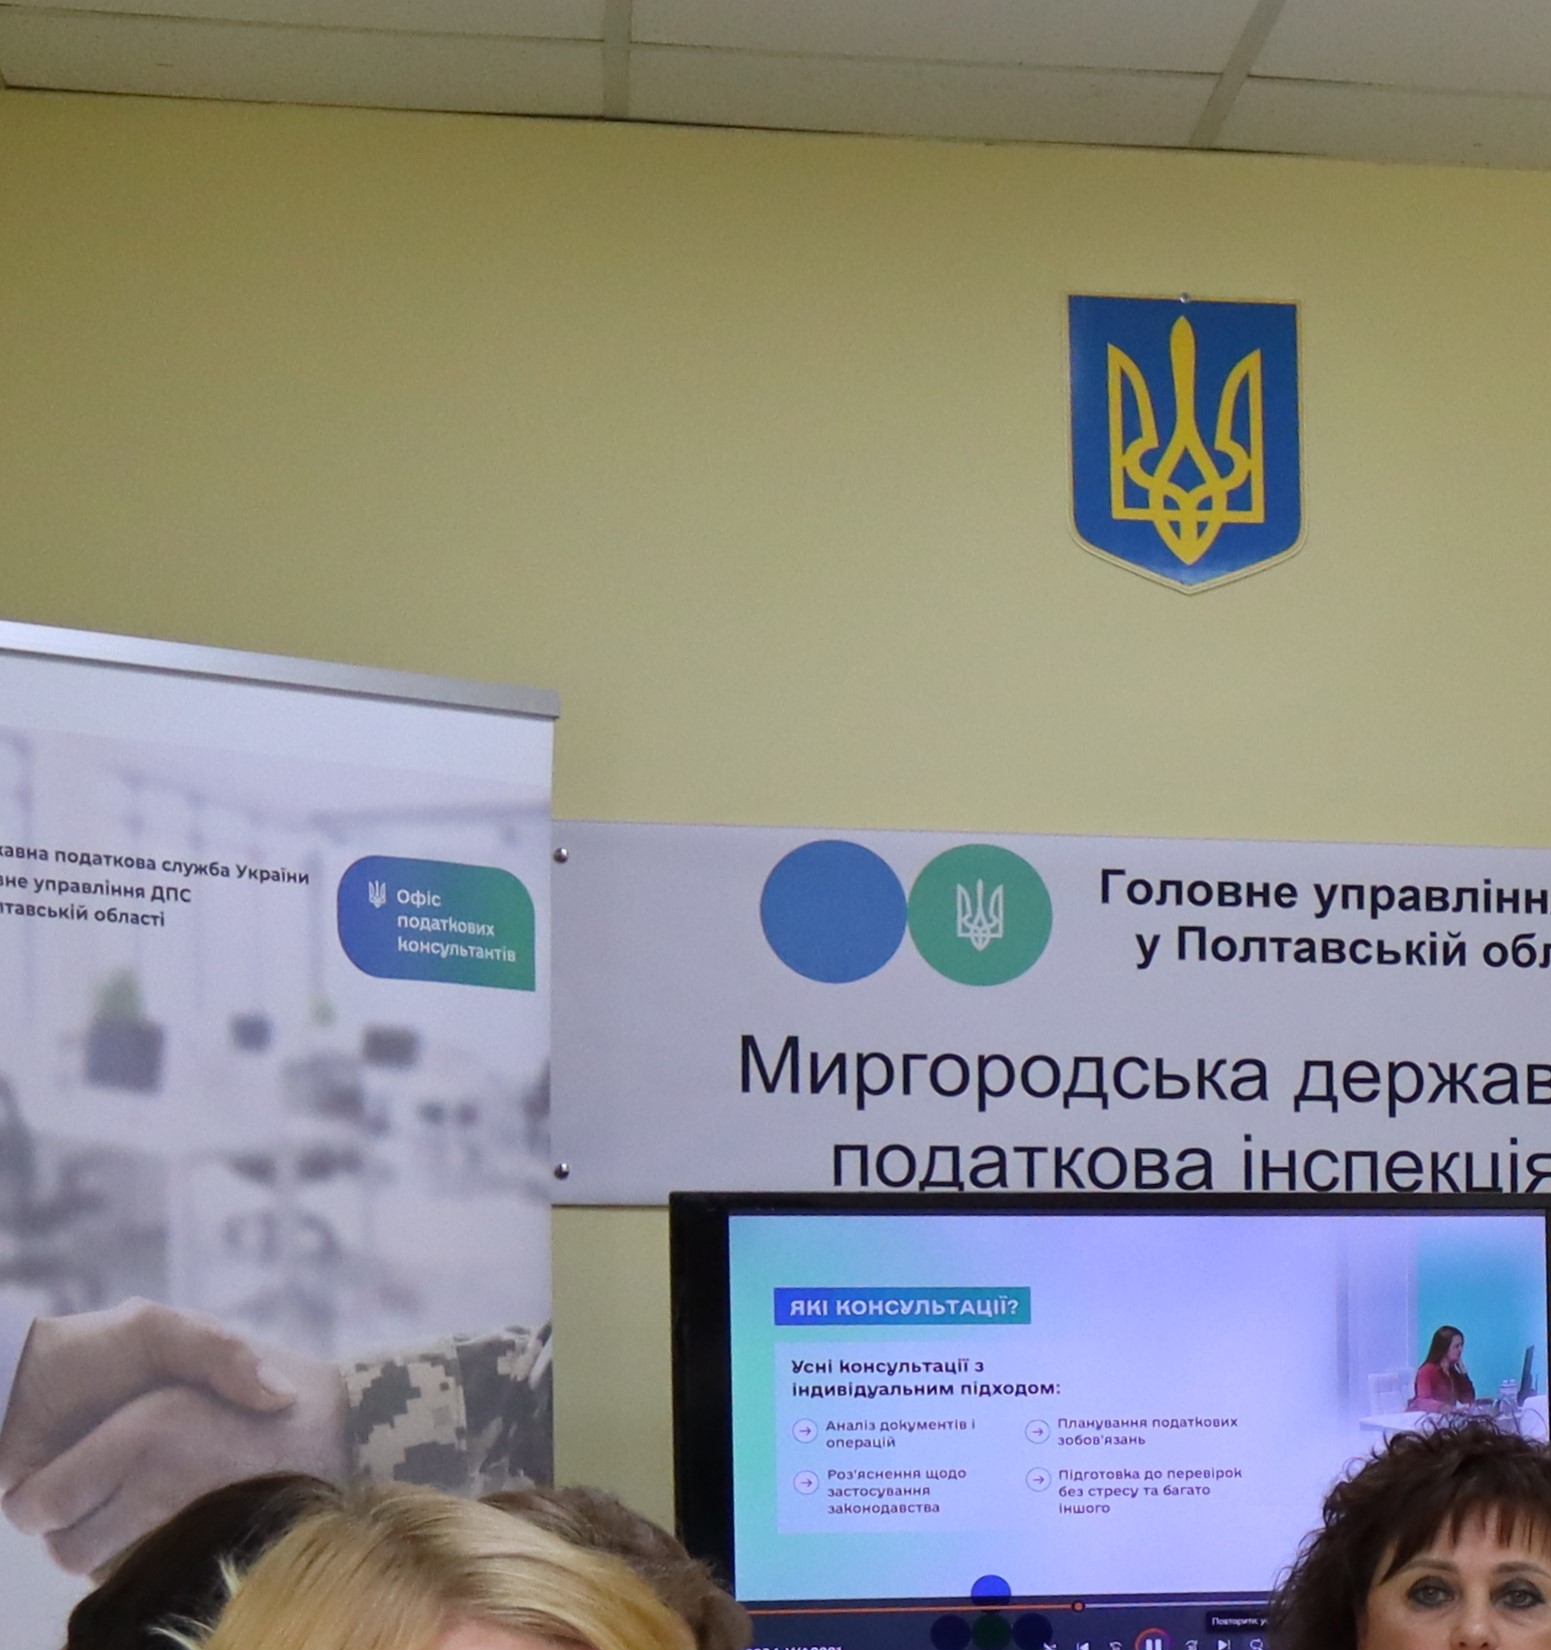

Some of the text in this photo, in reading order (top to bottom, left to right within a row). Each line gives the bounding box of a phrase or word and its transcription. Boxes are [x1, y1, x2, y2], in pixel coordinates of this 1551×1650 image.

[0, 845, 310, 885] авна податкова служба України
[33, 877, 145, 899] управління
[150, 886, 192, 903] ДПС
[397, 888, 441, 908] Офіс
[1099, 868, 1298, 911] Головне
[94, 908, 165, 927] області
[397, 914, 495, 936] податкових
[398, 936, 516, 962] консультантів
[1135, 931, 1162, 970] у
[1176, 924, 1468, 971] Полтавській
[740, 1034, 1269, 1110] Миргородська
[833, 1143, 1213, 1192] податкова
[790, 1295, 1019, 1317] ЯКІ КОНСУЛЬТАЦІЇ?
[791, 1358, 985, 1376] Усні консультації з
[792, 1380, 1061, 1399] індивідуальним підходом:
[826, 1419, 876, 1432] Аналіз
[880, 1418, 967, 1433] документів
[1058, 1415, 1239, 1431] Планування податкових
[826, 1435, 896, 1450] операцій
[925, 1468, 967, 1482] щодо
[1058, 1467, 1242, 1482] Підготовка до перевірок
[827, 1486, 930, 1500] застосування
[1058, 1484, 1211, 1498] без стресу та багато
[827, 1501, 940, 1515] законодавства
[1058, 1503, 1111, 1515] іншого
